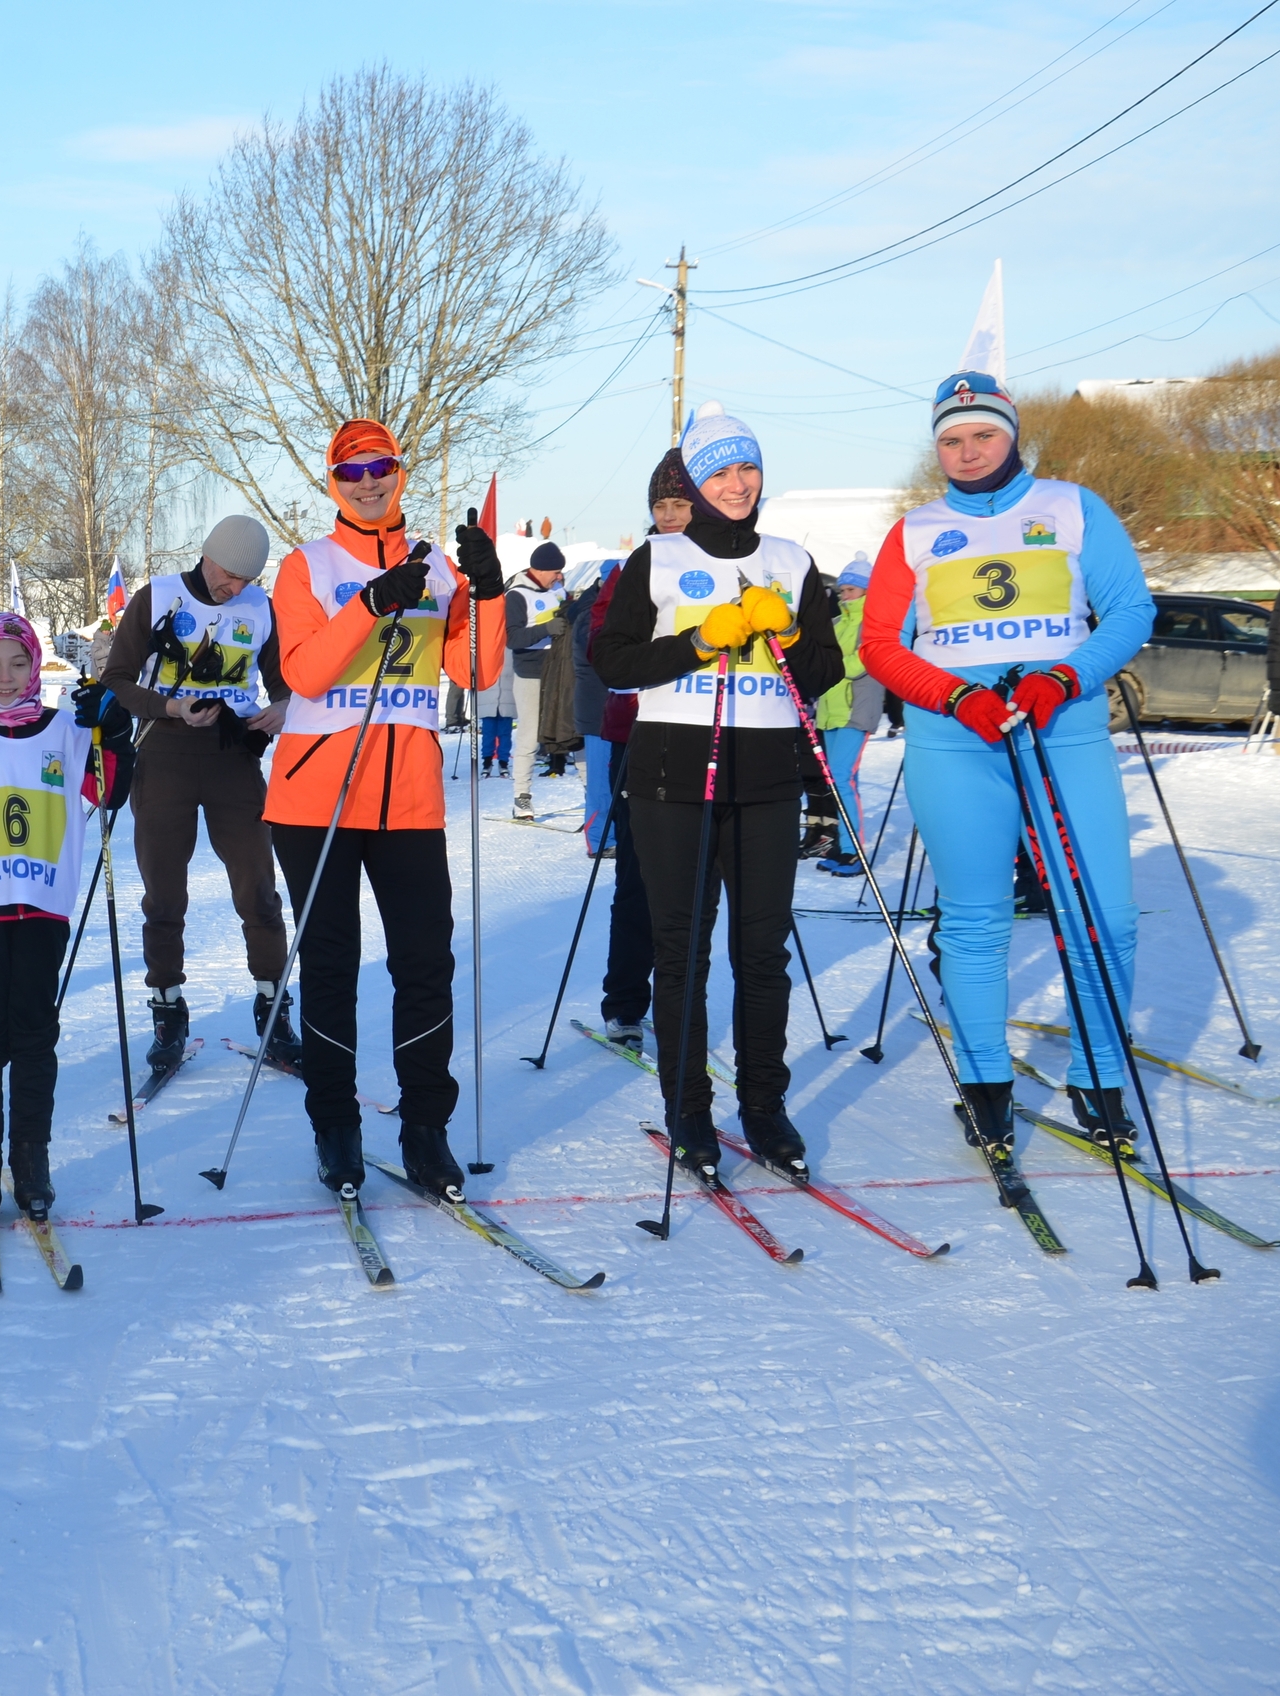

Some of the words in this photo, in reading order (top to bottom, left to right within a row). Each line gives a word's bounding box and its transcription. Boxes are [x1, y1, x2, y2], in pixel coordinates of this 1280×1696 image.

[973, 559, 1020, 611] 3
[469, 597, 477, 656] NORDWAY
[933, 617, 1071, 646] ПЕЧОРЫ
[379, 623, 414, 677] 2
[61, 687, 67, 696] 2
[326, 687, 438, 710] ПЕЧОРЫ
[674, 673, 791, 697] ПЕЧОРЫ
[3, 793, 31, 847] 6
[1022, 1212, 1060, 1250] FISCHER
